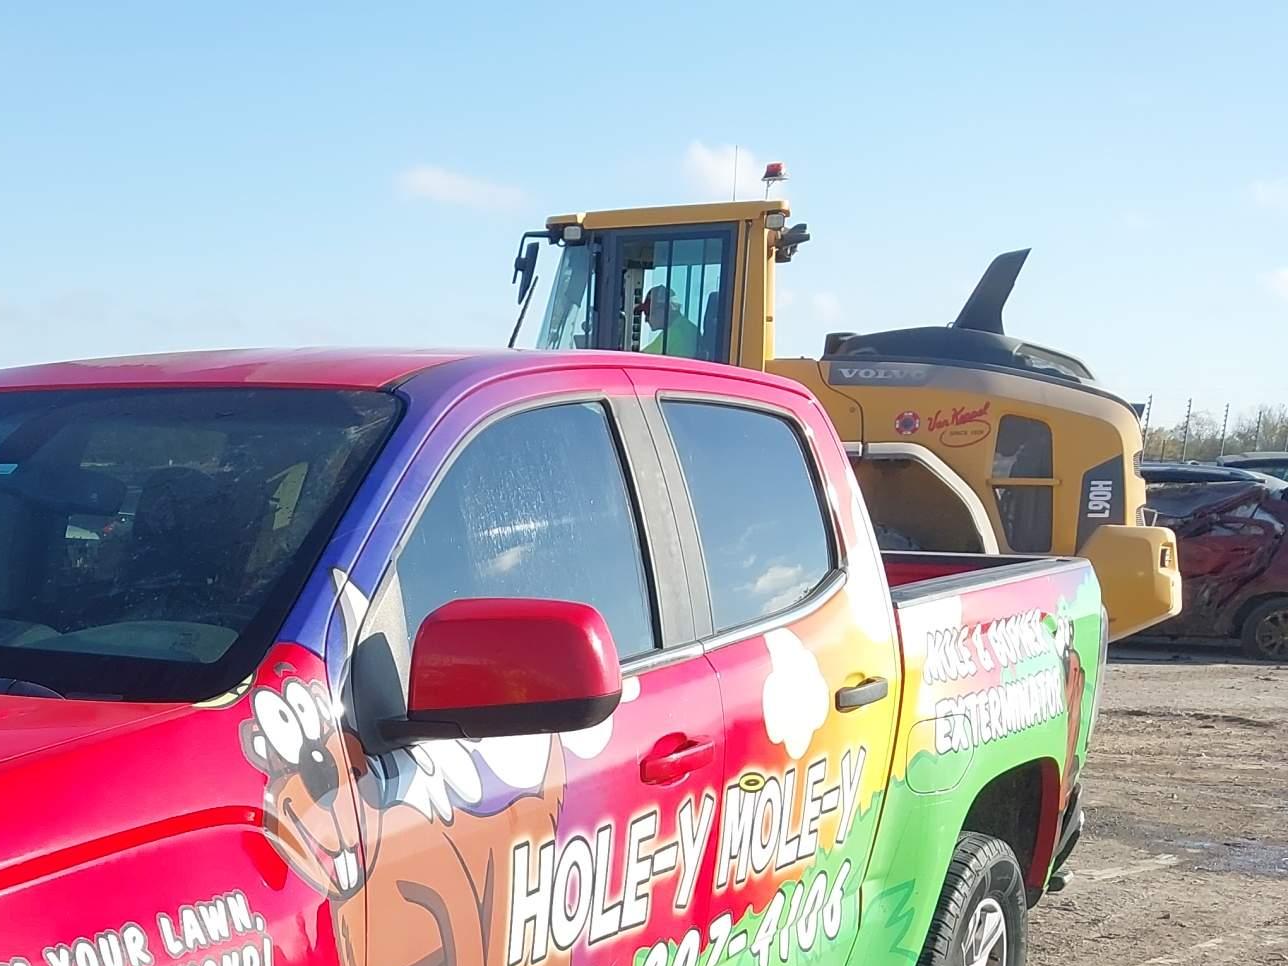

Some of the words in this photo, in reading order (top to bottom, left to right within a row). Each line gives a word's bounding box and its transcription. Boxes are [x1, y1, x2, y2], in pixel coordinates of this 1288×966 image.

[838, 367, 927, 380] VOLVO
[1087, 480, 1112, 518] L90H
[923, 624, 978, 686] MOLE
[971, 622, 995, 672] &
[934, 665, 1064, 755] EXTERMINATOR
[716, 746, 867, 889] MOLE-Y
[160, 889, 266, 956] LAWN,
